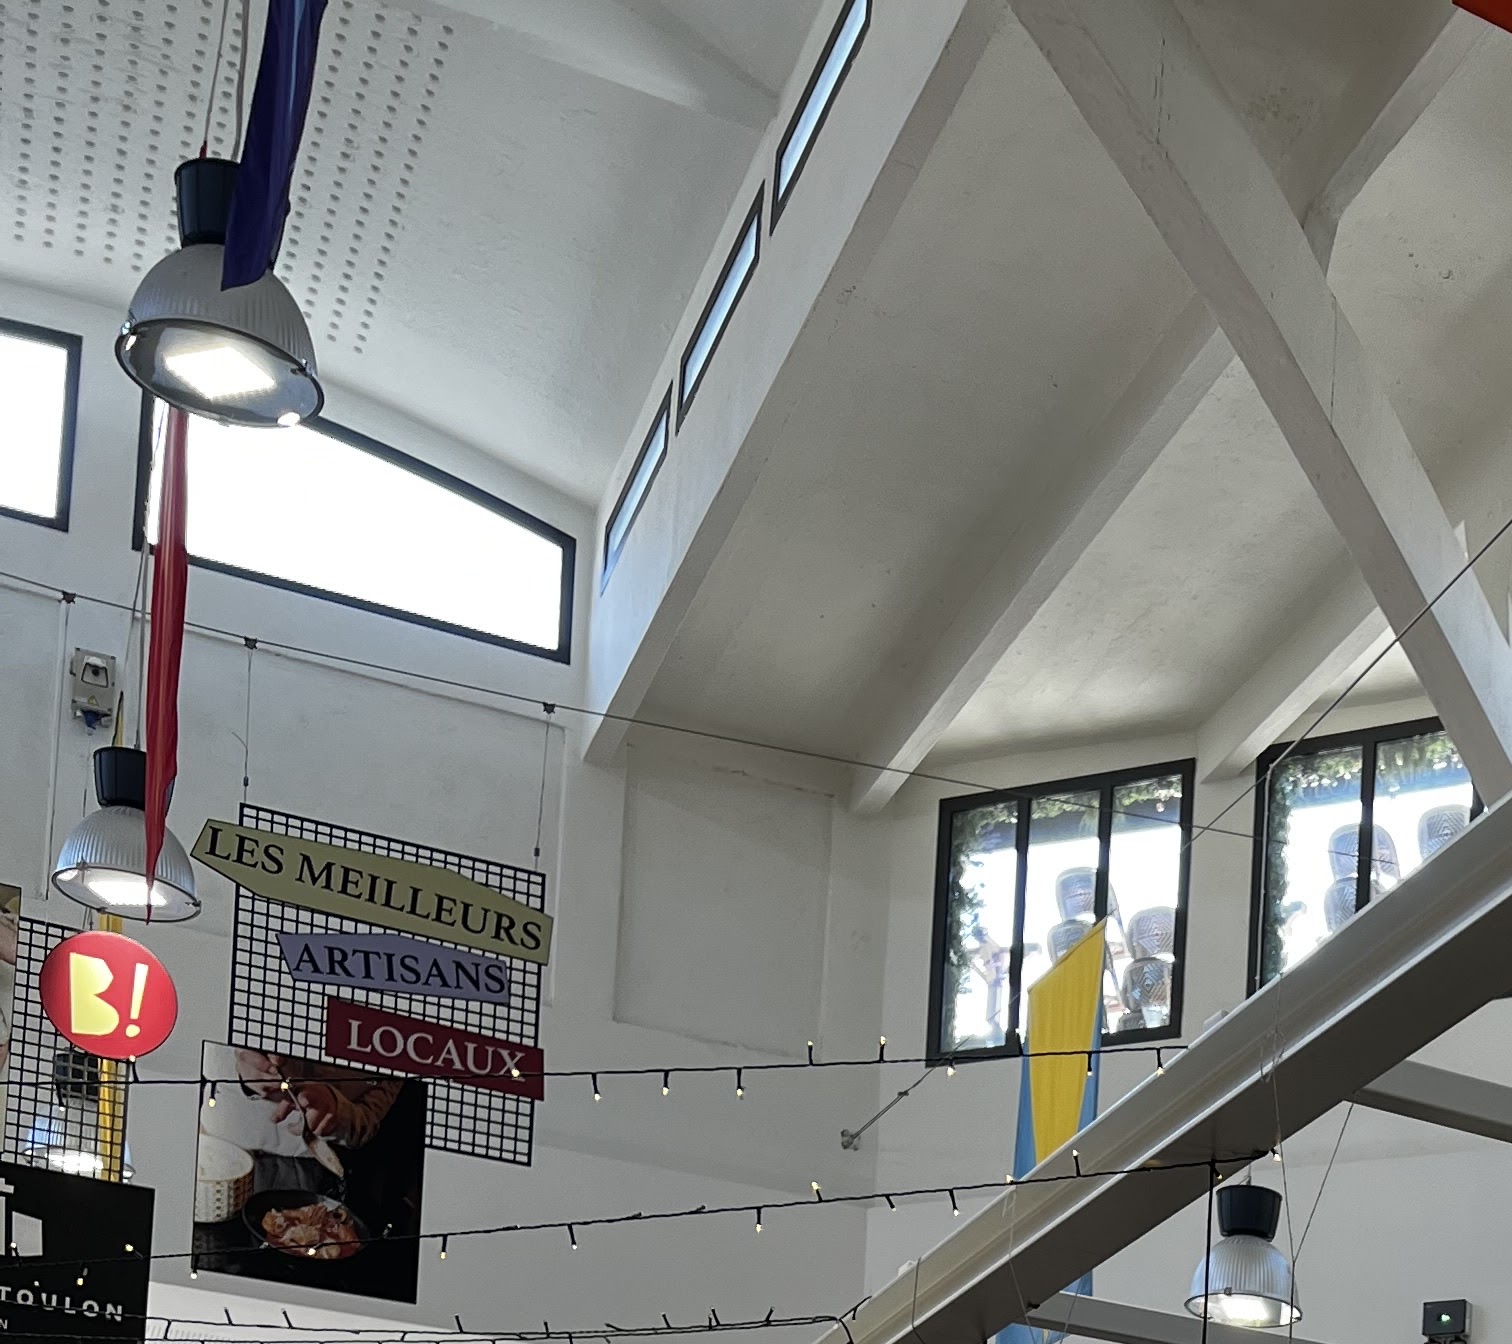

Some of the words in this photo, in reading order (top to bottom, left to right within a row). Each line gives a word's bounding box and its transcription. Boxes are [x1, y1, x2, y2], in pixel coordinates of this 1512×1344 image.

[203, 826, 284, 876] LES
[295, 852, 543, 950] MEILLEURS
[292, 944, 506, 994] ARTISANS
[347, 1020, 526, 1081] LOCAUX
[0, 1286, 122, 1322] TOULON
